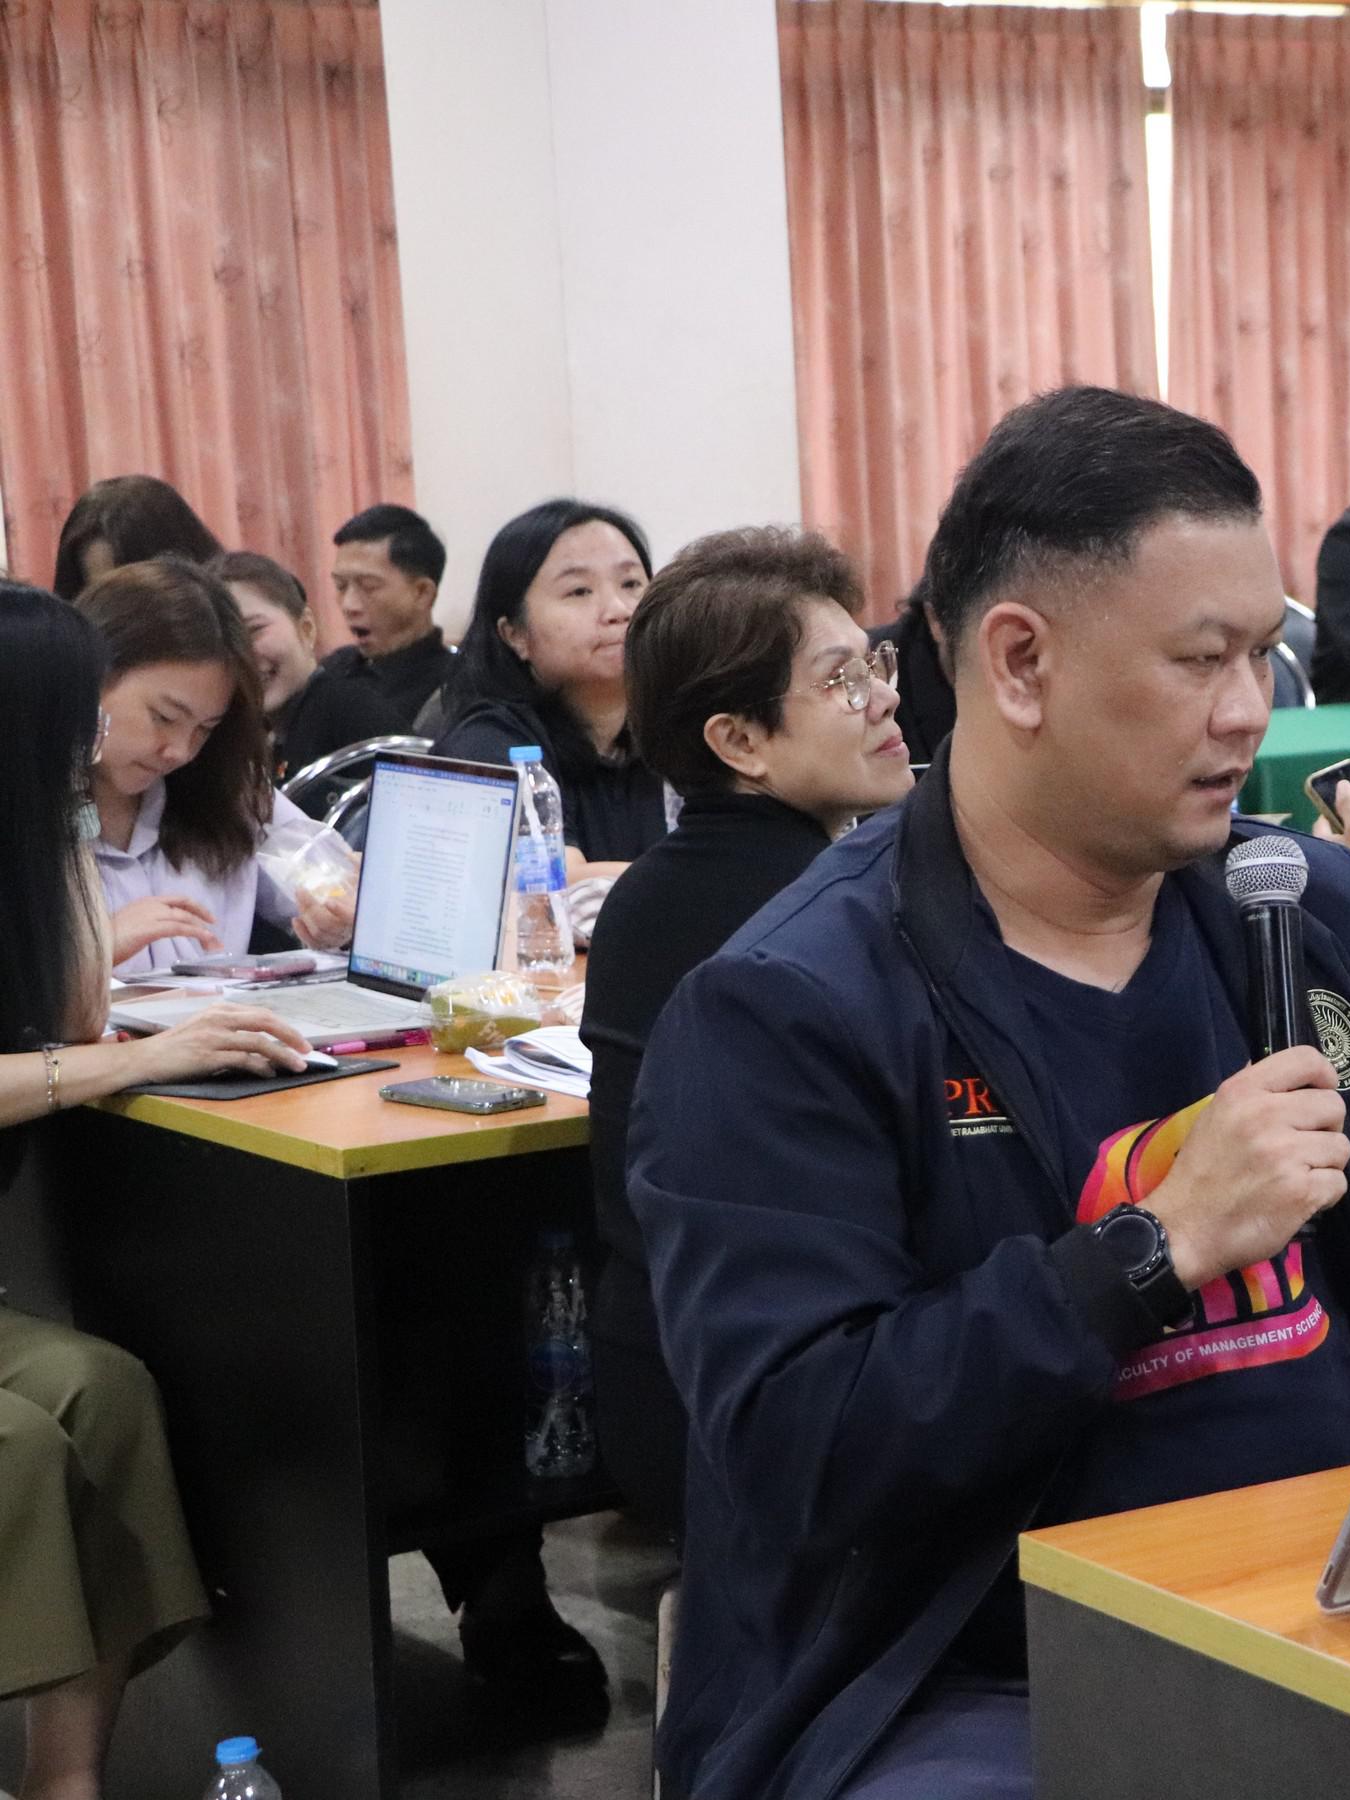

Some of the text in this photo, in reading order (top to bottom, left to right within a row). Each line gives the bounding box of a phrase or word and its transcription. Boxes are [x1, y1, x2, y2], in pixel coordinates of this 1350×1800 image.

[1118, 1301, 1324, 1381] CULTY OF MANAGEMENT SCIENC
